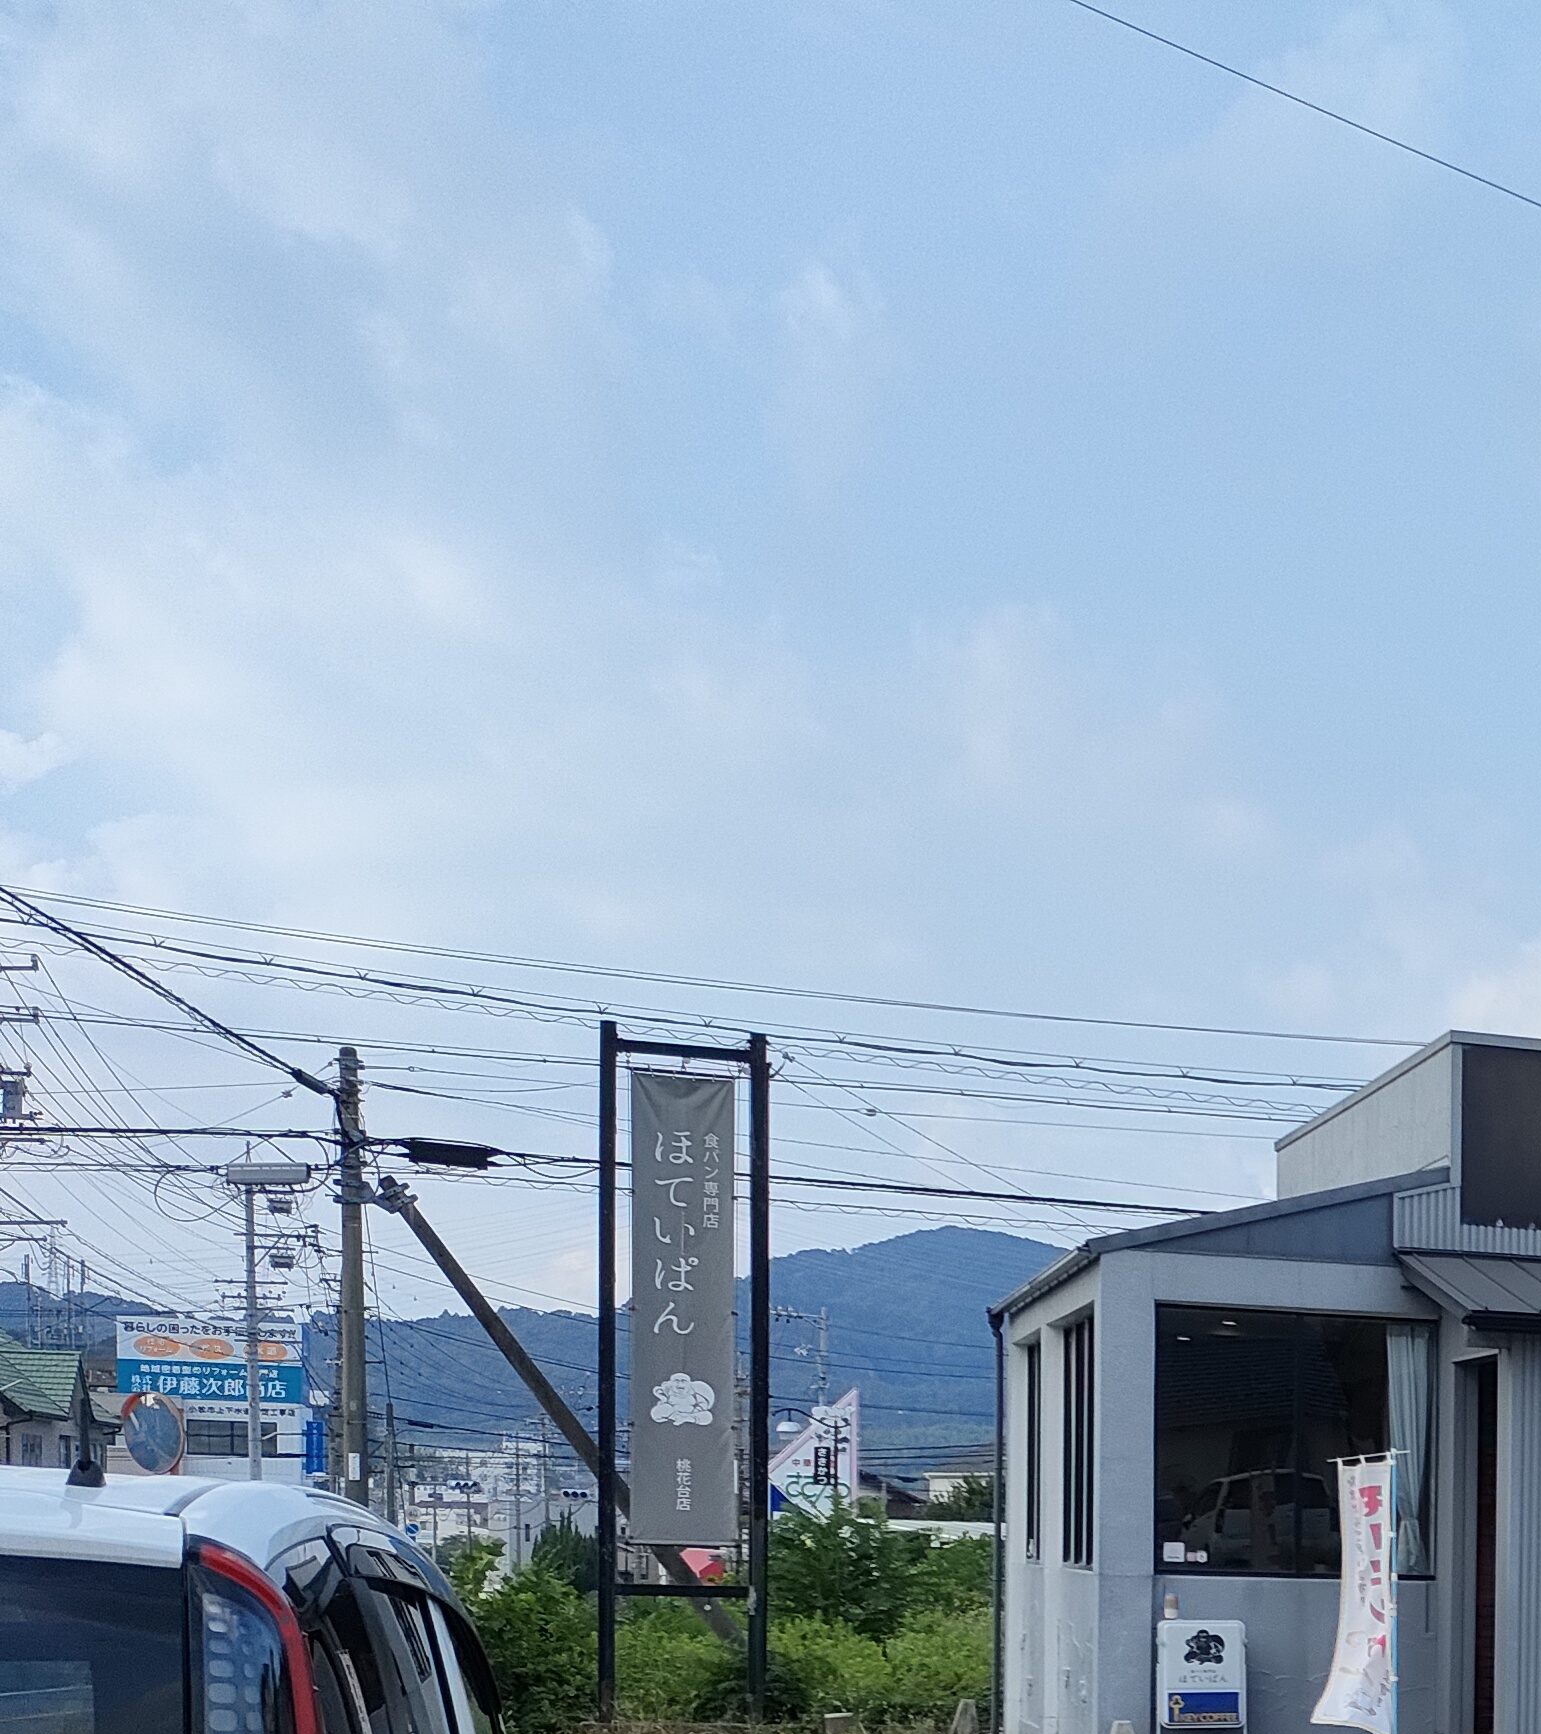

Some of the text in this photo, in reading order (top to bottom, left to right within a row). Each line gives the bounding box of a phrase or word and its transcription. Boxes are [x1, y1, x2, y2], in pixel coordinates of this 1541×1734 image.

[702, 1132, 720, 1229] 食パン専門店
[653, 1131, 700, 1335] ほていぱん
[676, 1458, 692, 1511] 桃花台店
